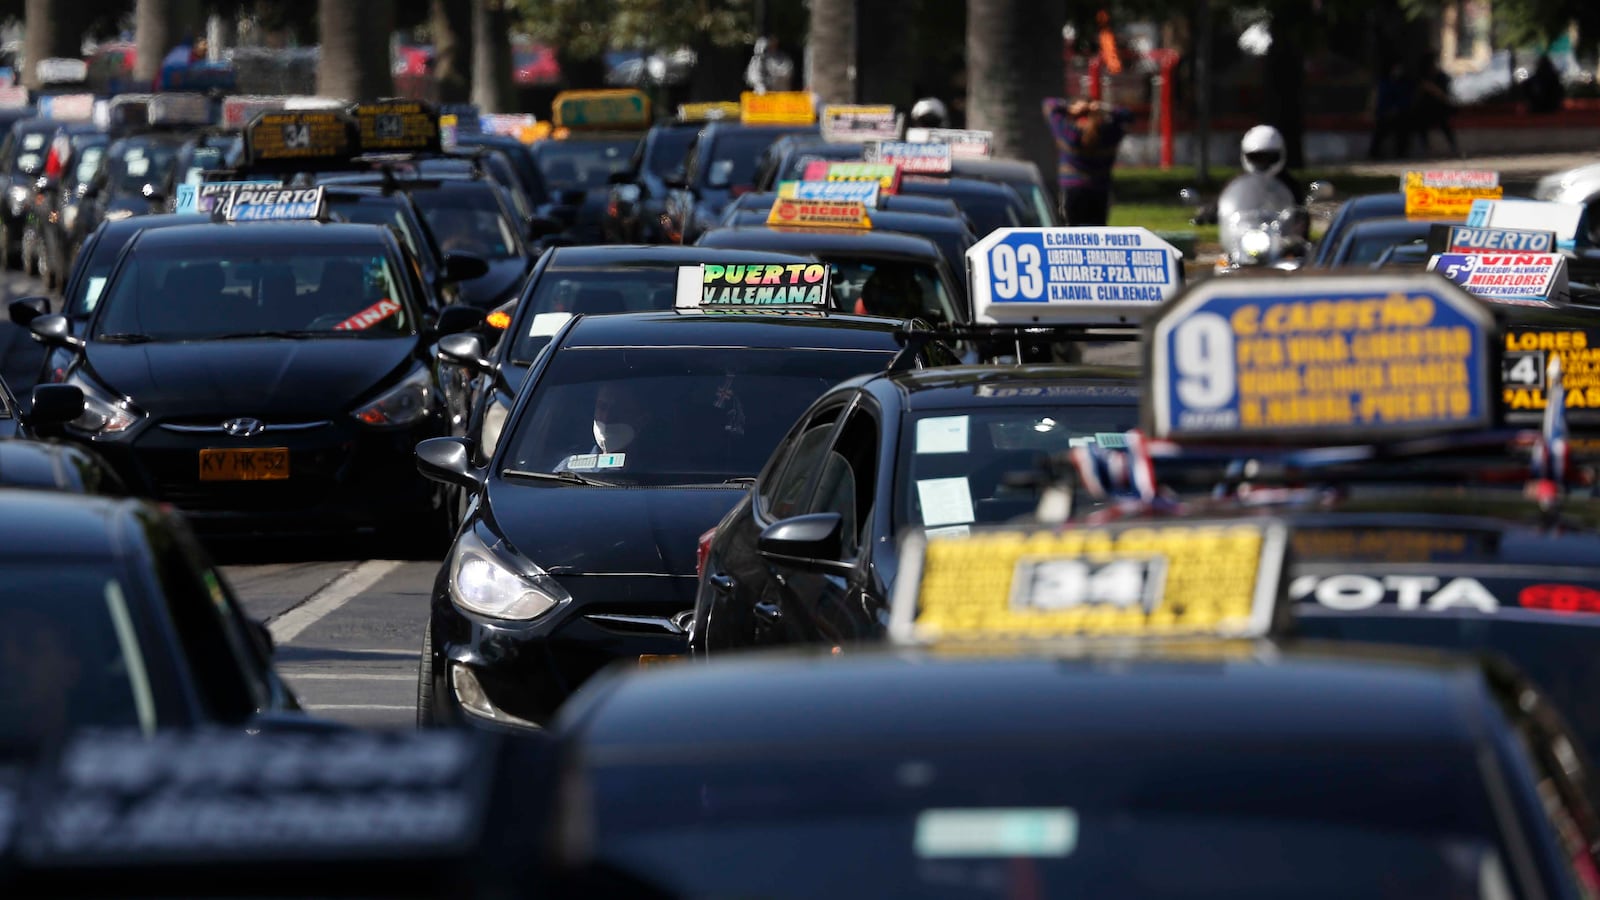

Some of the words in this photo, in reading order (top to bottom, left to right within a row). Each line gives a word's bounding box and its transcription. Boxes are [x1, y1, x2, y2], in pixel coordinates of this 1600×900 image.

[286, 125, 310, 148] 34
[180, 191, 195, 208] 77
[236, 189, 319, 205] PUERTO
[1105, 234, 1141, 246] PUERTO
[1454, 228, 1548, 250] PUERTO
[1047, 250, 1084, 265] LIBERTAD
[1086, 251, 1127, 265] ERRAZURIZ
[1481, 255, 1553, 266] VIÑA
[704, 264, 825, 284] PUERTO
[992, 244, 1044, 299] 93
[1049, 266, 1104, 281] ALVAREZ
[1470, 275, 1548, 286] MIRAFLORES
[704, 286, 822, 304] V.ALEMANA
[1051, 285, 1092, 300] H.NAVAL
[1506, 331, 1588, 352] LORES
[1174, 311, 1236, 409] 9
[1503, 387, 1600, 409] PALAS
[203, 452, 226, 472] KY
[1030, 559, 1143, 611] 34
